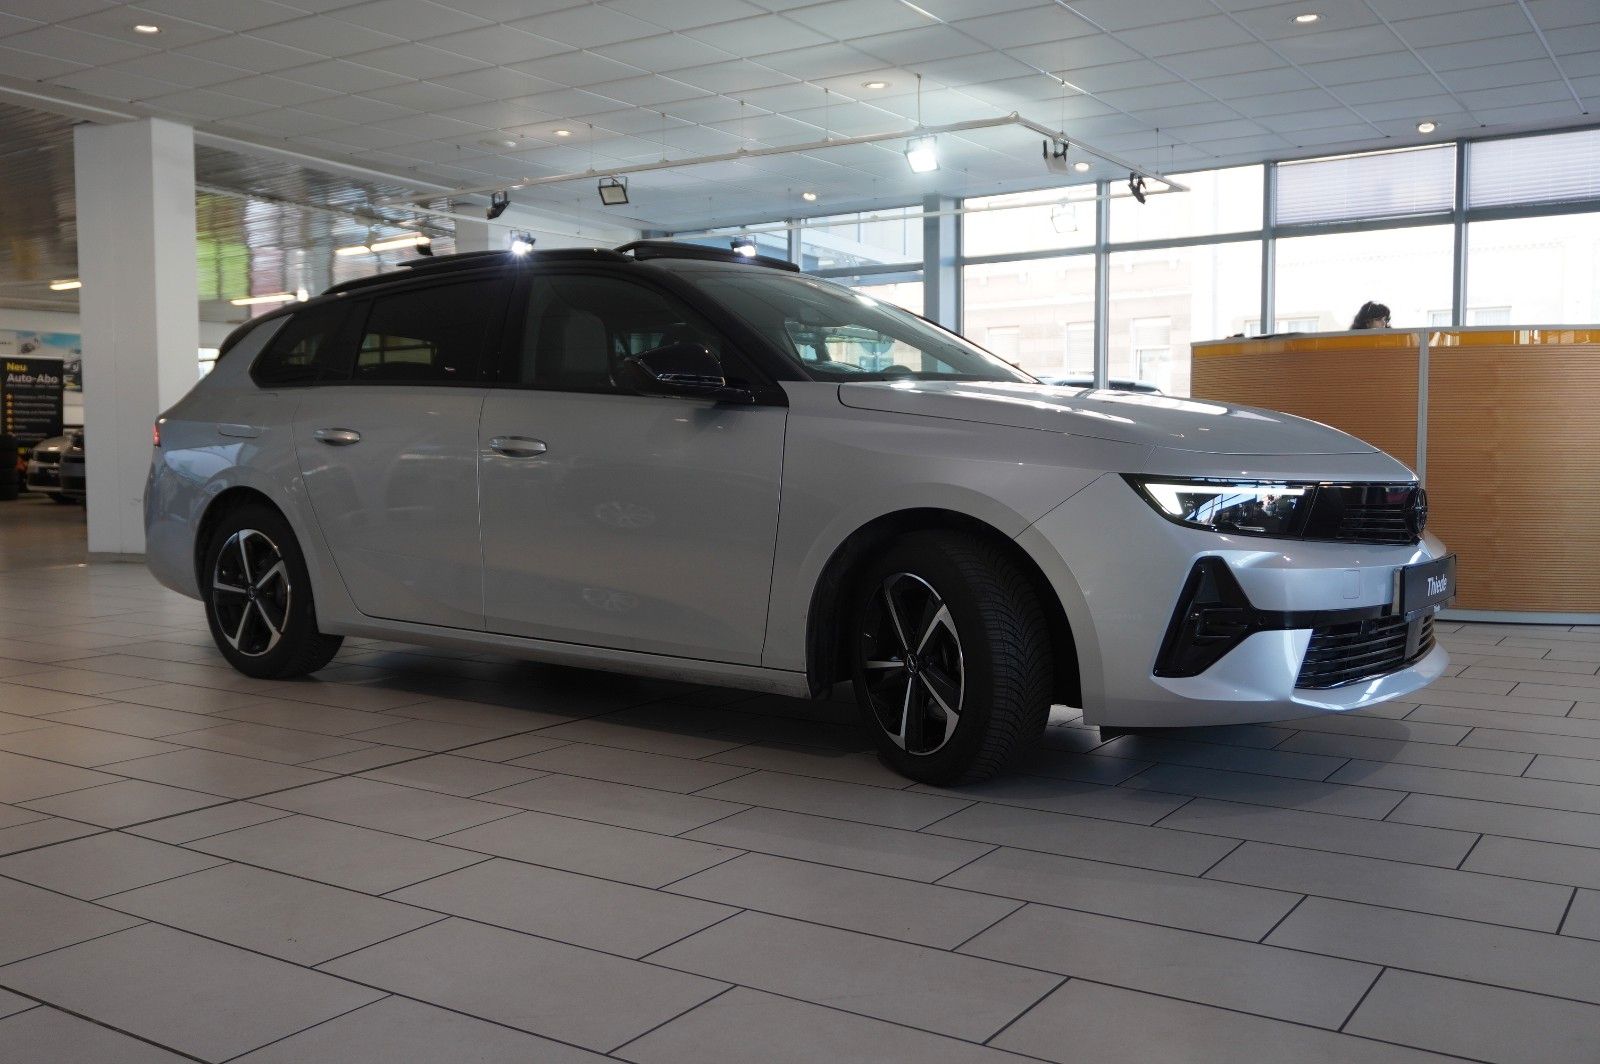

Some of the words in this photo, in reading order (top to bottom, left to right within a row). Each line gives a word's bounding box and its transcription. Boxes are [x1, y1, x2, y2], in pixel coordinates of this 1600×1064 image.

[6, 362, 26, 372] Neu
[7, 373, 58, 384] Auto-Abo
[1427, 574, 1447, 597] Thiede
